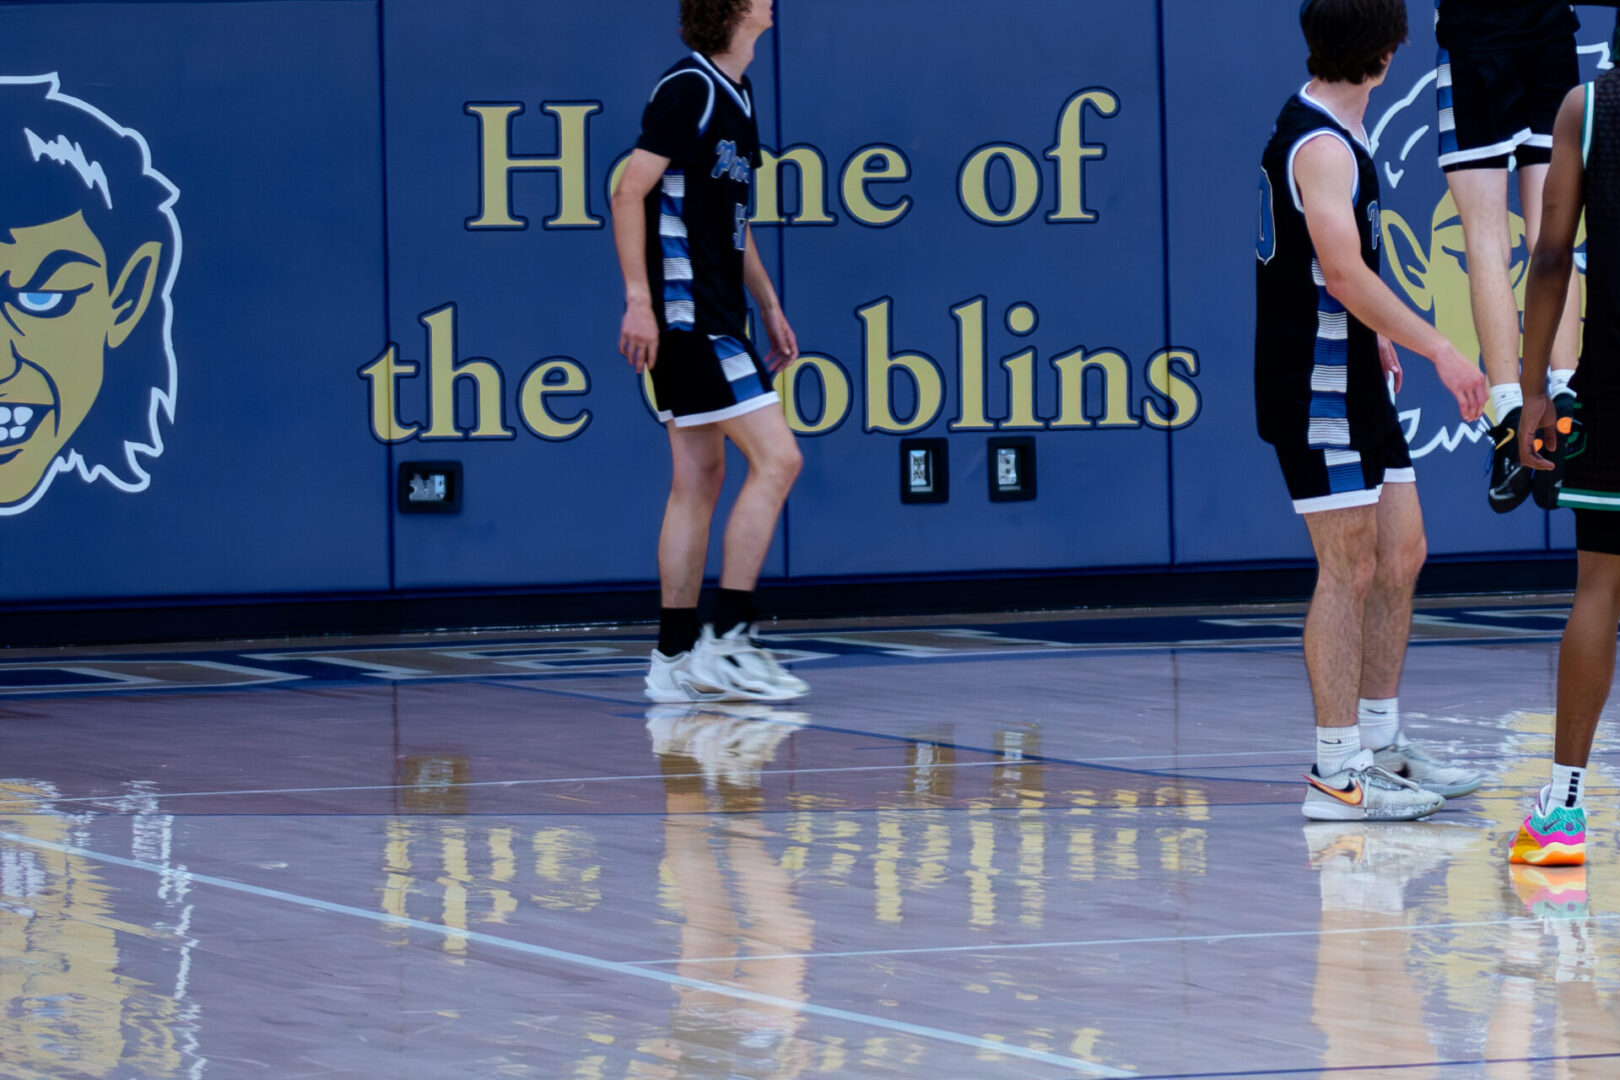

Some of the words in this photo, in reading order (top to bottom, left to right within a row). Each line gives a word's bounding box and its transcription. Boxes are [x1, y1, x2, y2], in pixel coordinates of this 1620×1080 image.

[467, 102, 909, 229] Hme
[959, 88, 1119, 223] of
[361, 304, 589, 443] the
[641, 299, 1199, 440] oblins
